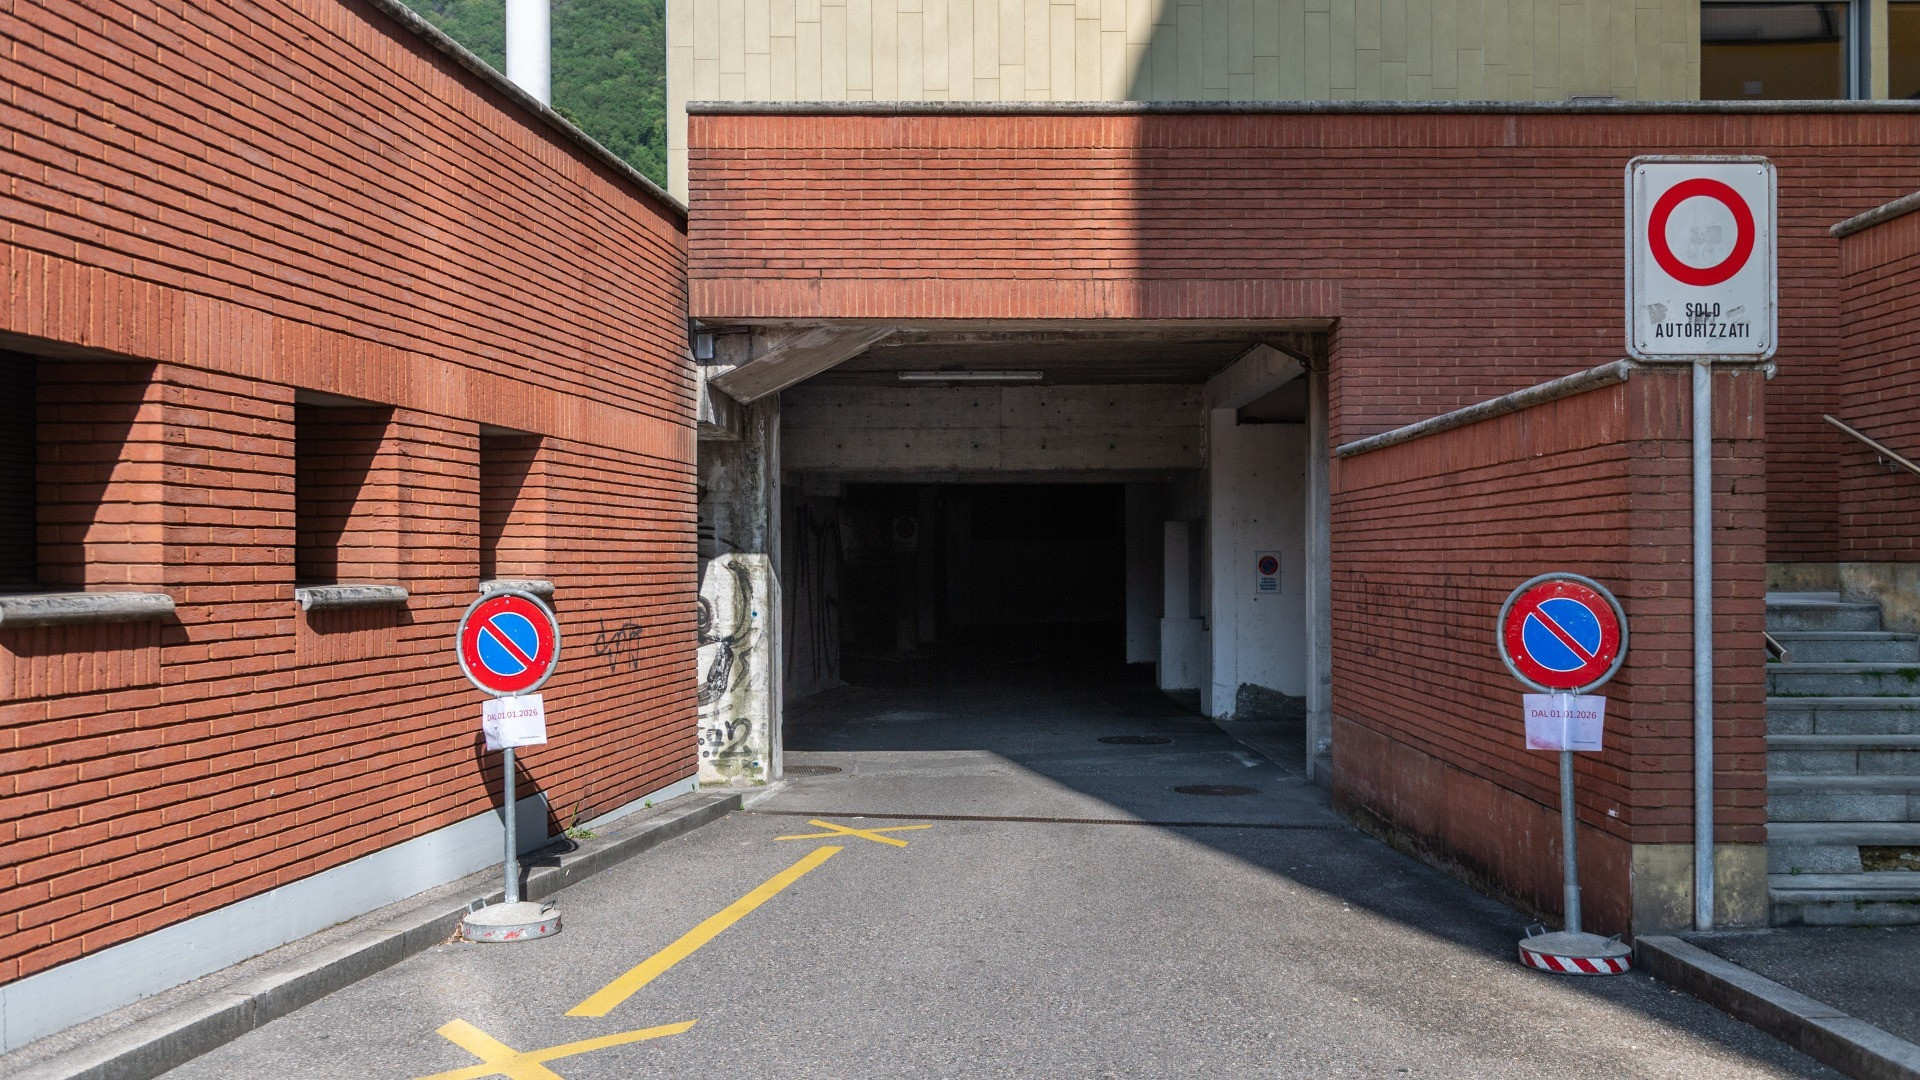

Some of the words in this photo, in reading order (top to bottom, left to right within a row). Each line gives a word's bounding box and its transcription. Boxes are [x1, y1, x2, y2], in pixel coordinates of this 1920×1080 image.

[1685, 302, 1720, 317] SOLO
[1655, 323, 1749, 338] AUTORIZZATI
[498, 709, 538, 719] 01.01.2026
[1531, 709, 1548, 718] DAL
[1550, 709, 1596, 719] 01.01.2026
